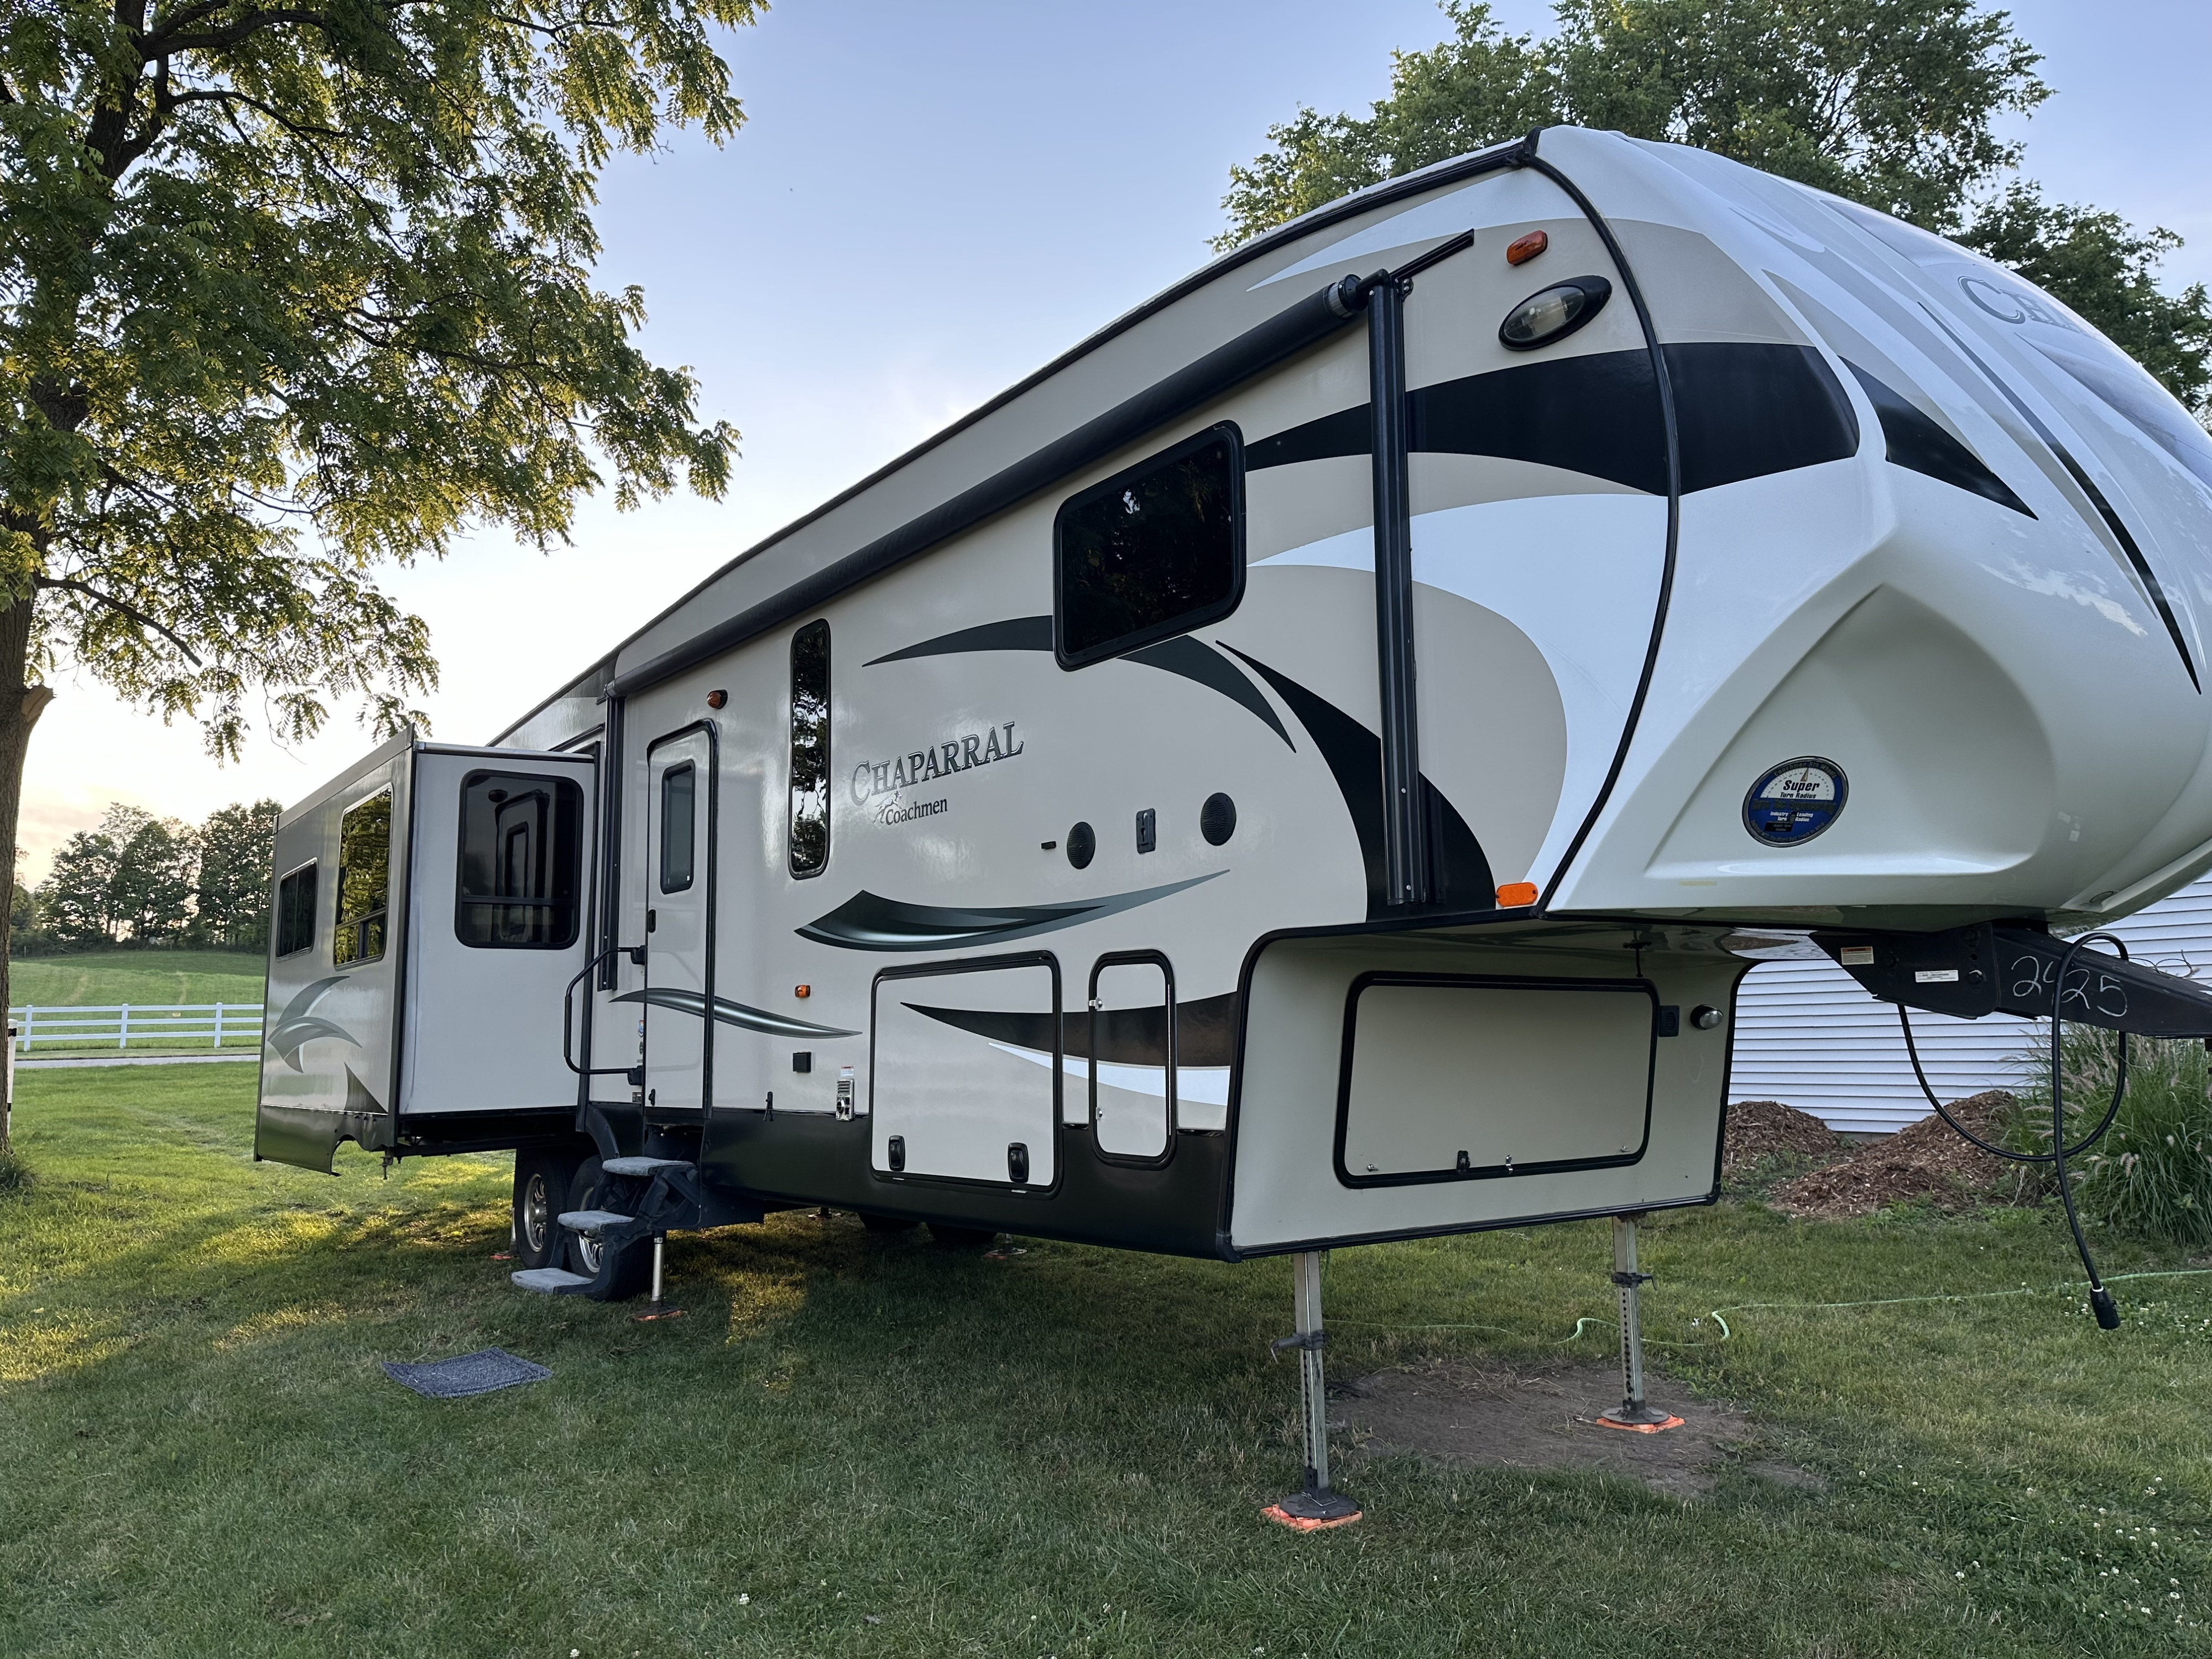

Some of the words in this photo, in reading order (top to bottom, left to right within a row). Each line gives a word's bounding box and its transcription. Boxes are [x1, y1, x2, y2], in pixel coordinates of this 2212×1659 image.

[850, 721, 1024, 806] CHAPARRAL
[1783, 780, 1820, 792] Super
[885, 799, 948, 826] Coachmen
